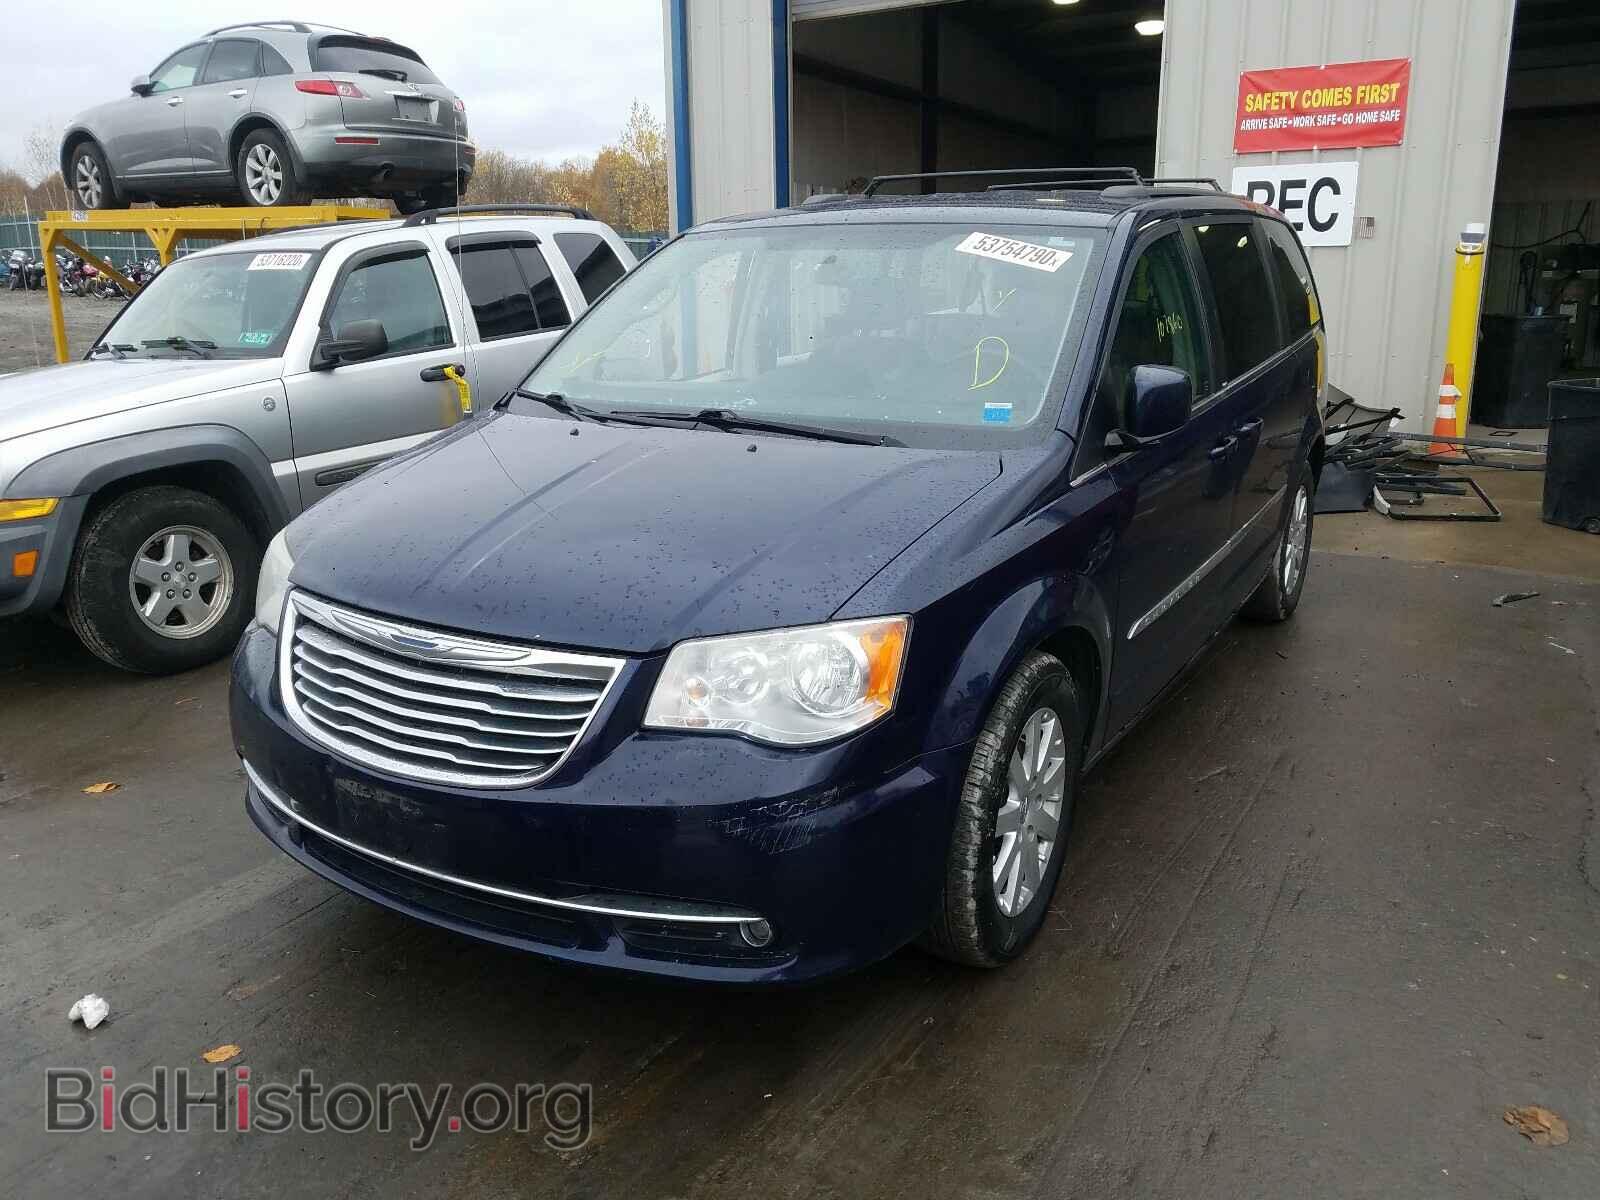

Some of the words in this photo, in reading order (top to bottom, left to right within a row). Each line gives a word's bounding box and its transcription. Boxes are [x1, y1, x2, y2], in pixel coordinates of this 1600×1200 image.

[1245, 90, 1299, 112] SAFETY
[1301, 86, 1353, 109] COMES
[1356, 82, 1400, 105] FIRST
[1240, 117, 1268, 131] ARRIVE
[1355, 110, 1379, 124] HOME
[1379, 108, 1401, 122] SAFE
